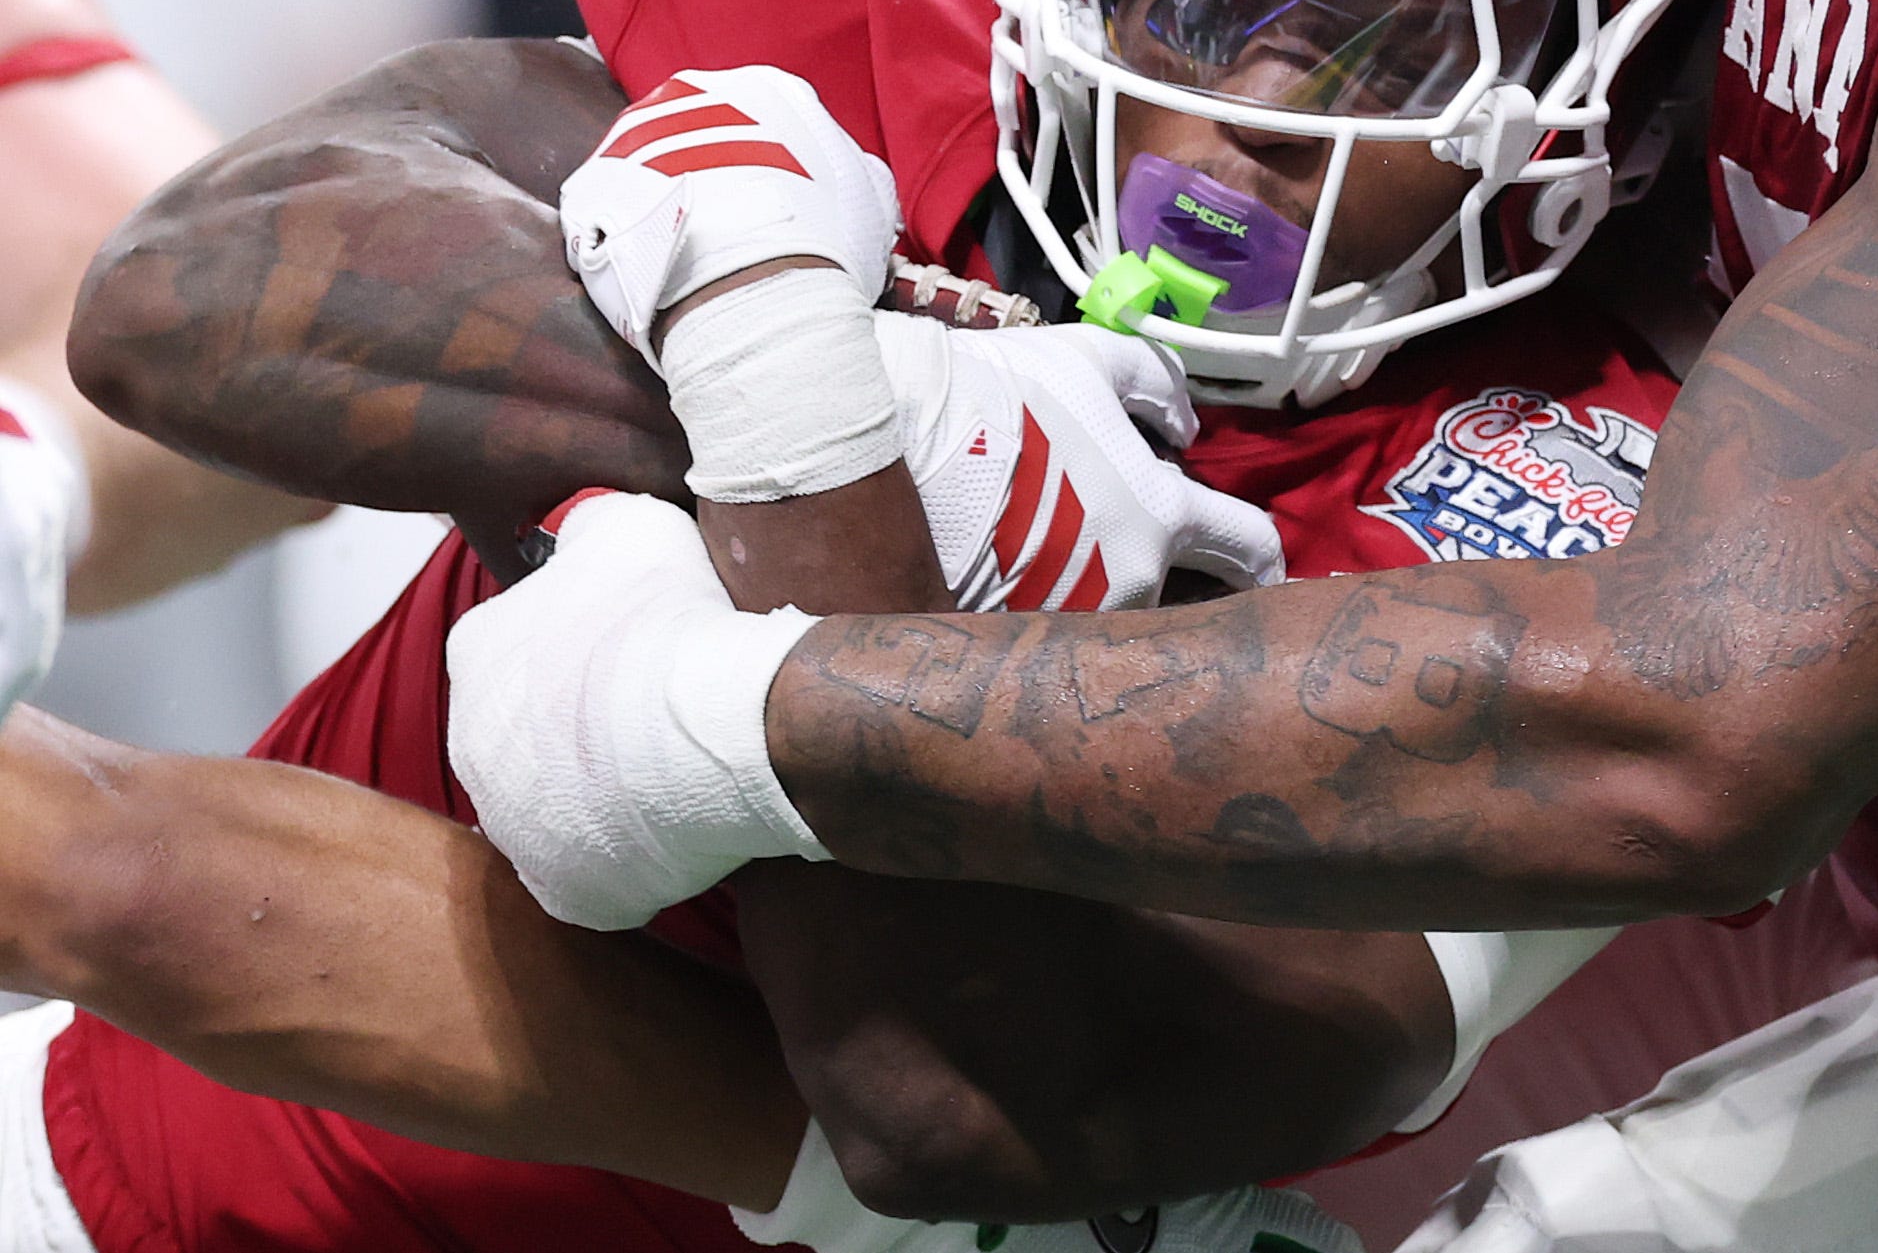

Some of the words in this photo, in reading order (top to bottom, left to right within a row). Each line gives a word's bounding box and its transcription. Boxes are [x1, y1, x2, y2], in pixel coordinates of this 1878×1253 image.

[1173, 192, 1249, 239] SHOCK
[1397, 448, 1603, 560] PEAC
[1449, 396, 1635, 545] Chick-fil-
[1430, 508, 1531, 560] BOW
